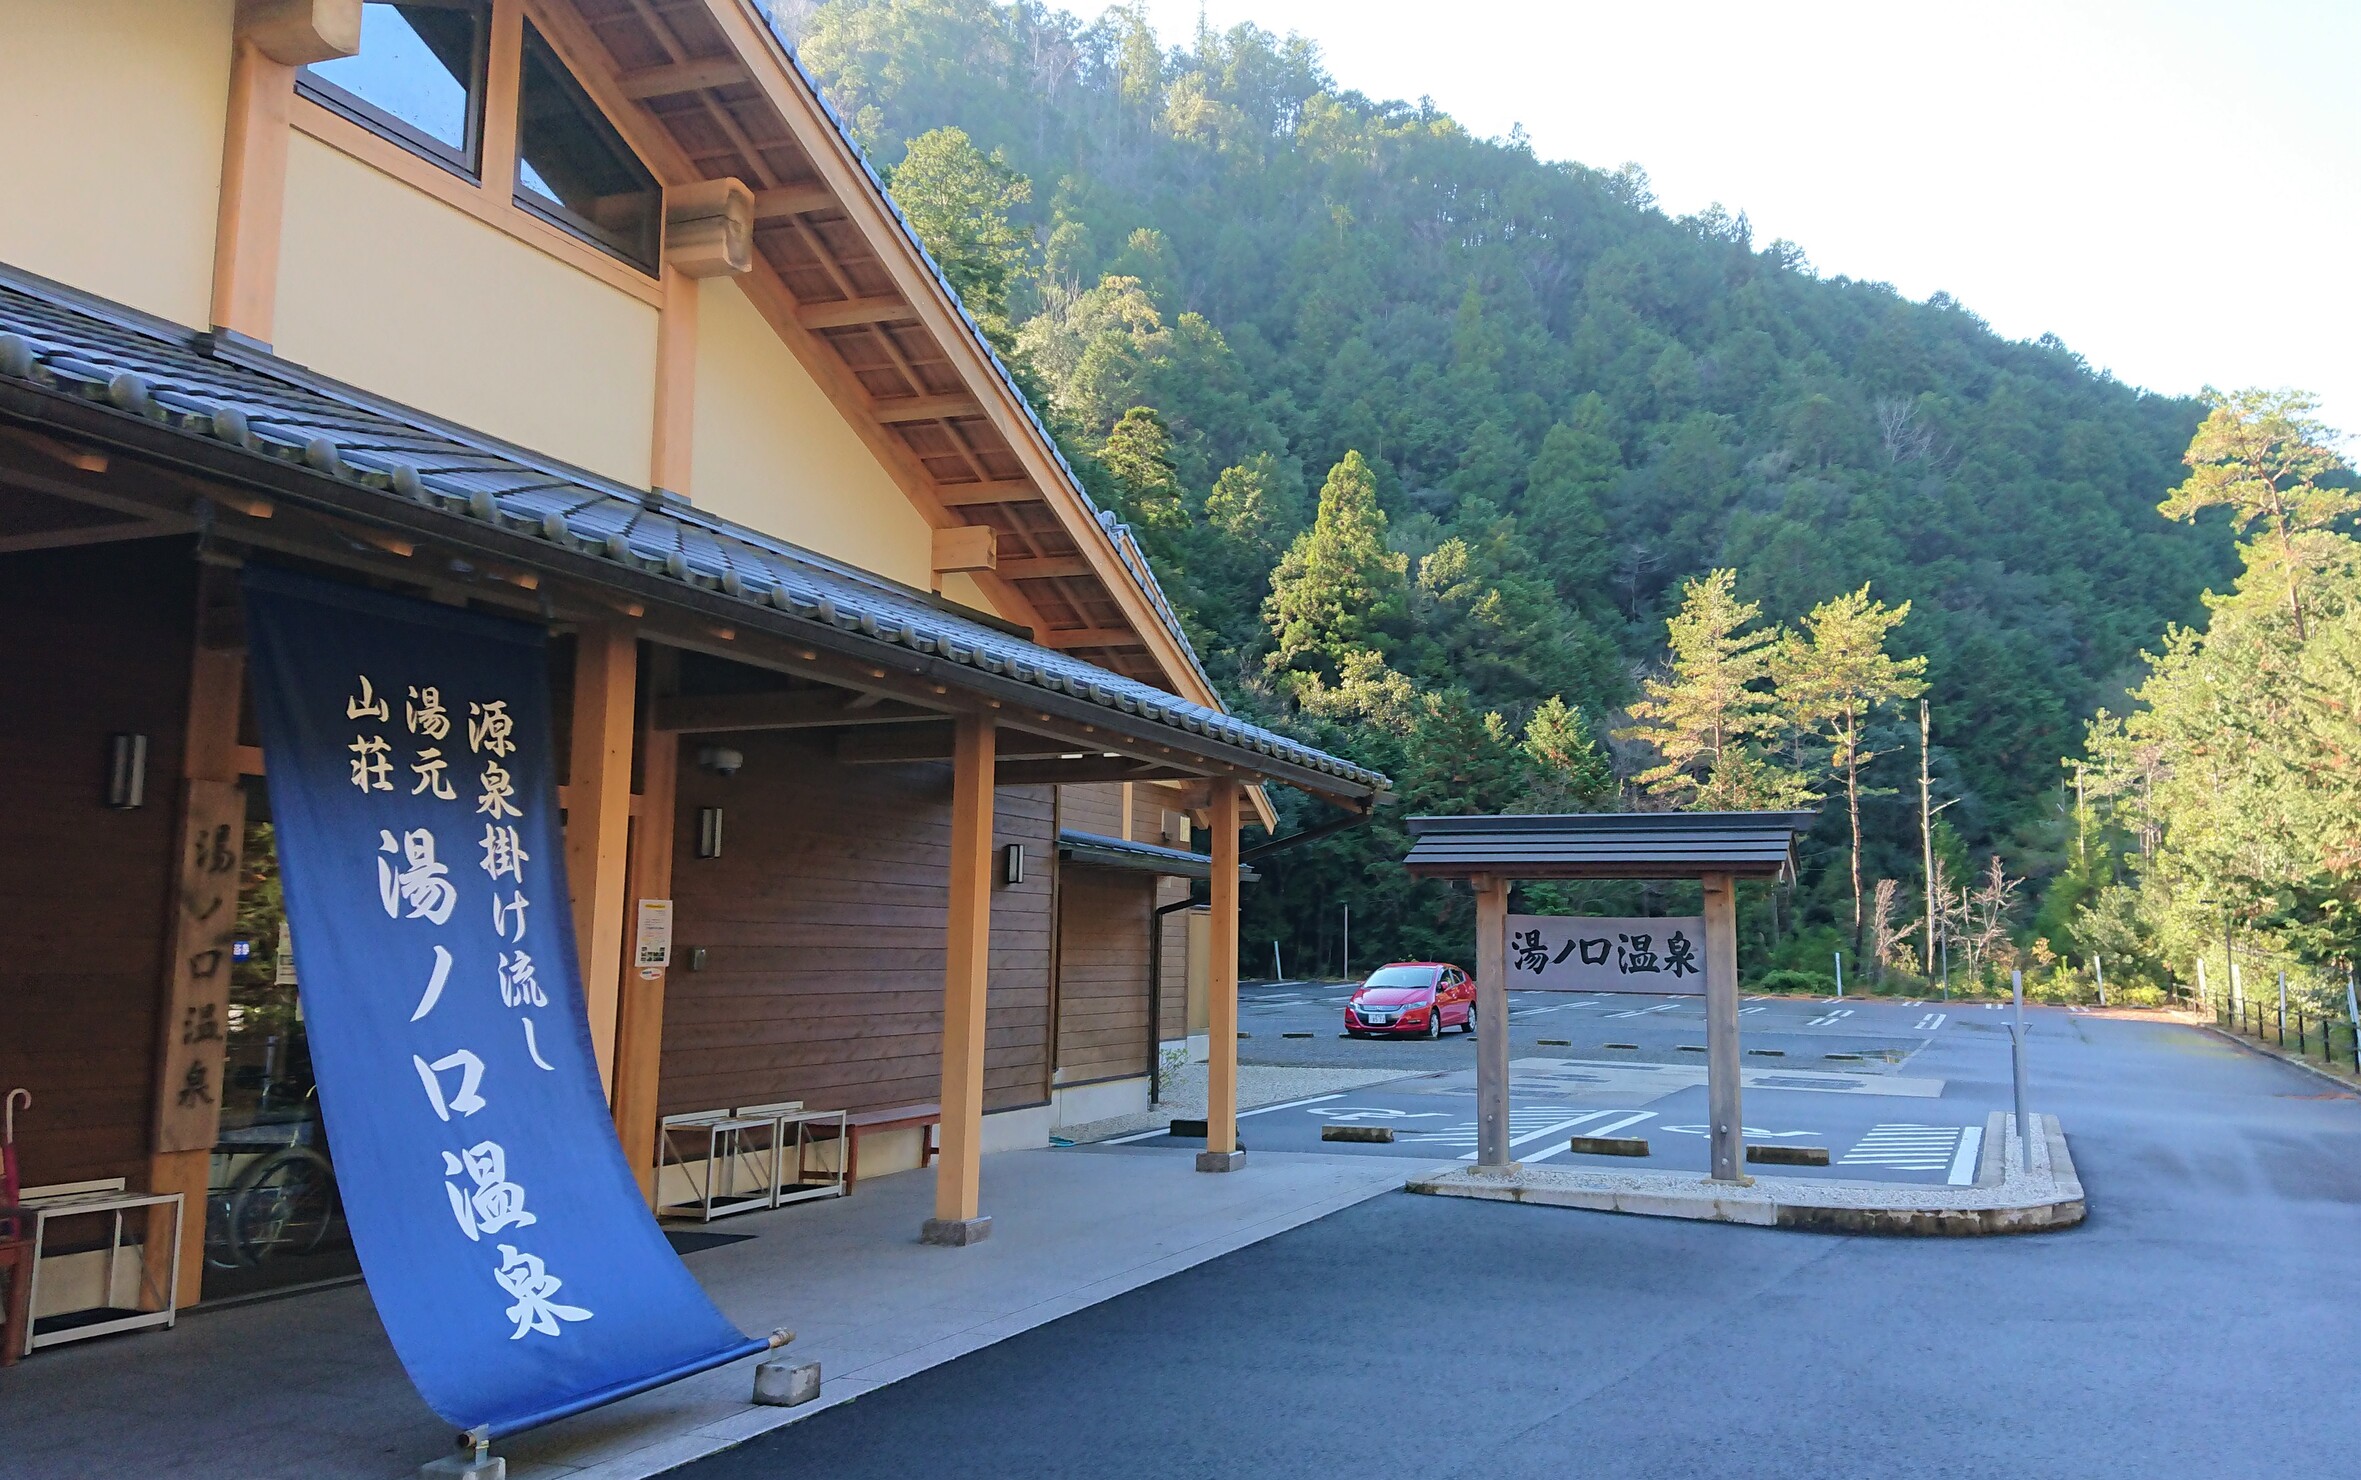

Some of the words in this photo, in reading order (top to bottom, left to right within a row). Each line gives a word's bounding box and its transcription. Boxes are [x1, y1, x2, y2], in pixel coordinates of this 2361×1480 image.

[347, 676, 394, 794] 山荘
[406, 686, 457, 801] 湯元
[468, 700, 555, 1071] 源泉掛け流し
[1511, 929, 1700, 978] 湯ノ口温泉
[378, 827, 594, 1340] 湯ノ口温泉
